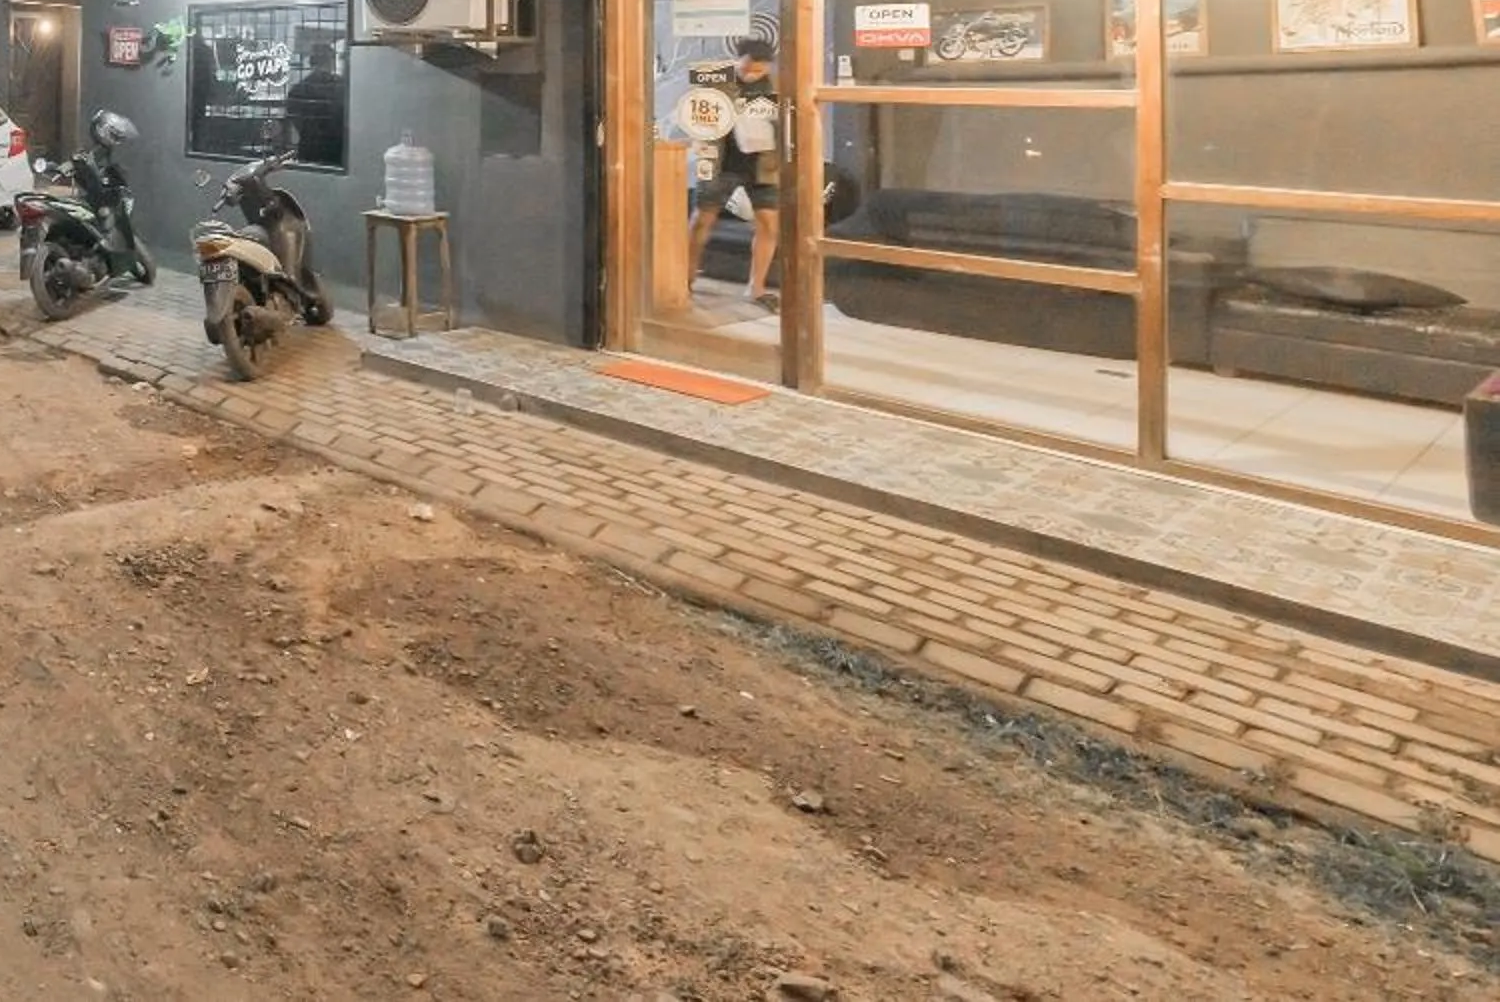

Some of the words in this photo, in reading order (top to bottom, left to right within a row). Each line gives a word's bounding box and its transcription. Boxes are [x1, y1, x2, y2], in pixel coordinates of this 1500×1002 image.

[868, 9, 914, 19] OPEN
[697, 73, 727, 83] OPEN
[690, 98, 723, 115] 18+
